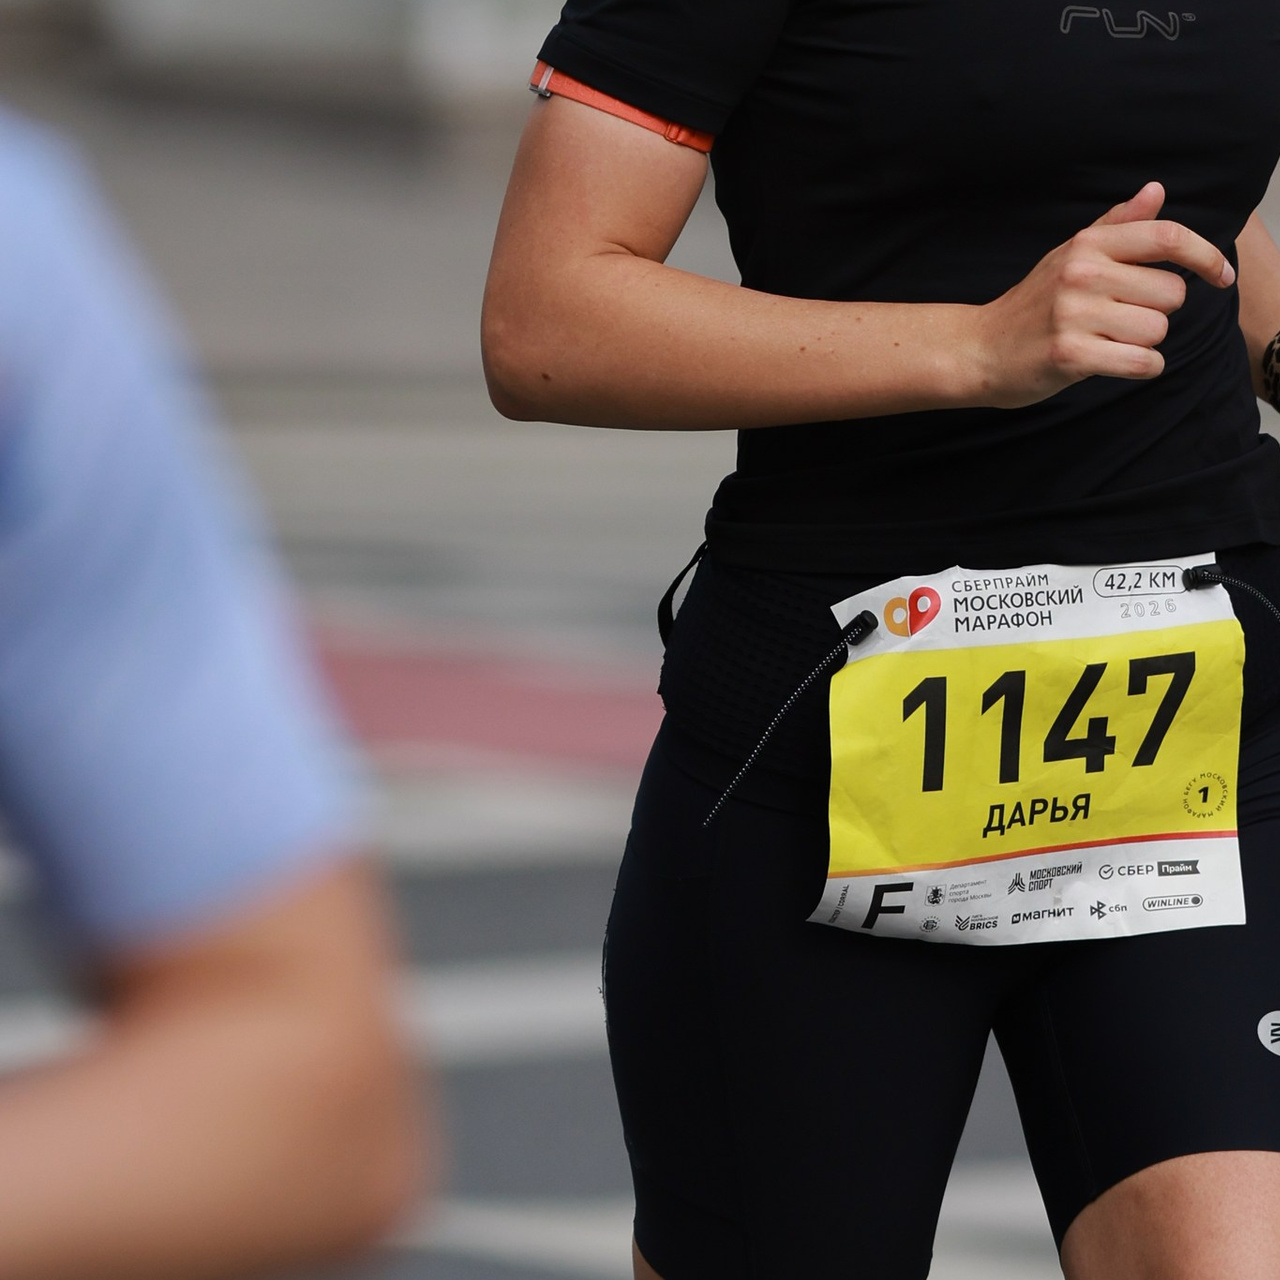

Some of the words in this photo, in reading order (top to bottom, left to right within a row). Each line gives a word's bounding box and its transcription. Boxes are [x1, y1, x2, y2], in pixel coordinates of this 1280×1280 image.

[952, 572, 1049, 593] СБЕРПРАЙМ
[1105, 571, 1142, 593] 42,2
[953, 585, 1083, 613] МОСКОВСКИЙ
[1120, 598, 1177, 618] 2026
[955, 610, 1052, 633] МАРАФОН
[902, 651, 1196, 792] 1147
[1198, 786, 1209, 803] 1
[982, 793, 1090, 838] ДАРЬЯ
[1029, 861, 1083, 881] МОСКОВСКИЙ
[1118, 864, 1155, 877] СБЕР
[1161, 863, 1193, 874] Прайм
[1028, 878, 1053, 892] СПОРТ
[861, 882, 914, 929] F
[1108, 904, 1128, 913] сбп
[1147, 898, 1190, 909] WINLINE
[1022, 906, 1074, 922] магнит
[969, 920, 998, 930] BRICS
